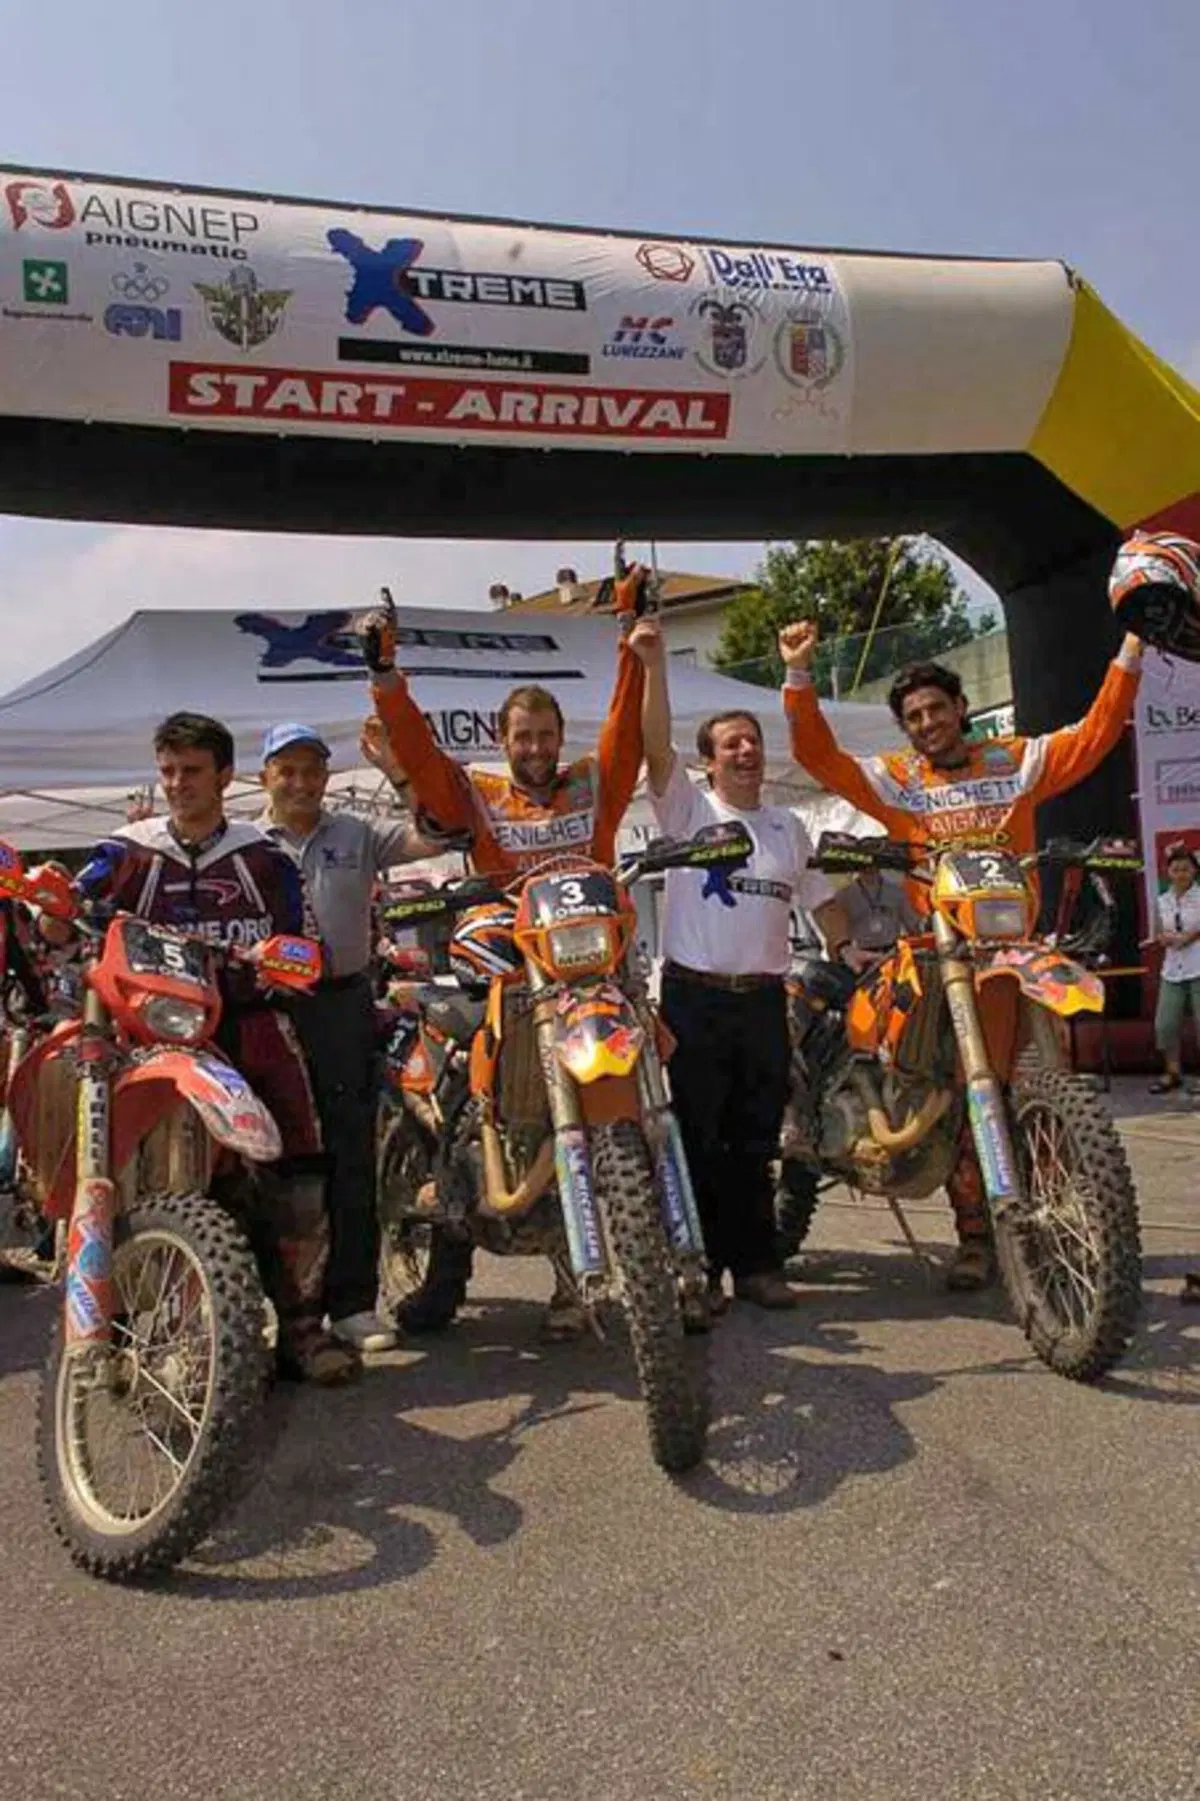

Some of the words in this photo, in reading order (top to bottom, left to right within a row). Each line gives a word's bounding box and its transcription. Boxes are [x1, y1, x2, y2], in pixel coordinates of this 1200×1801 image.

[81, 195, 258, 242] AIGNEP
[86, 231, 248, 260] pneumatic
[187, 373, 405, 416] START
[416, 401, 435, 411] -
[445, 387, 715, 429] ARRIVAL
[979, 859, 1004, 879] 2
[559, 880, 586, 906] 3
[163, 942, 187, 970] 5
